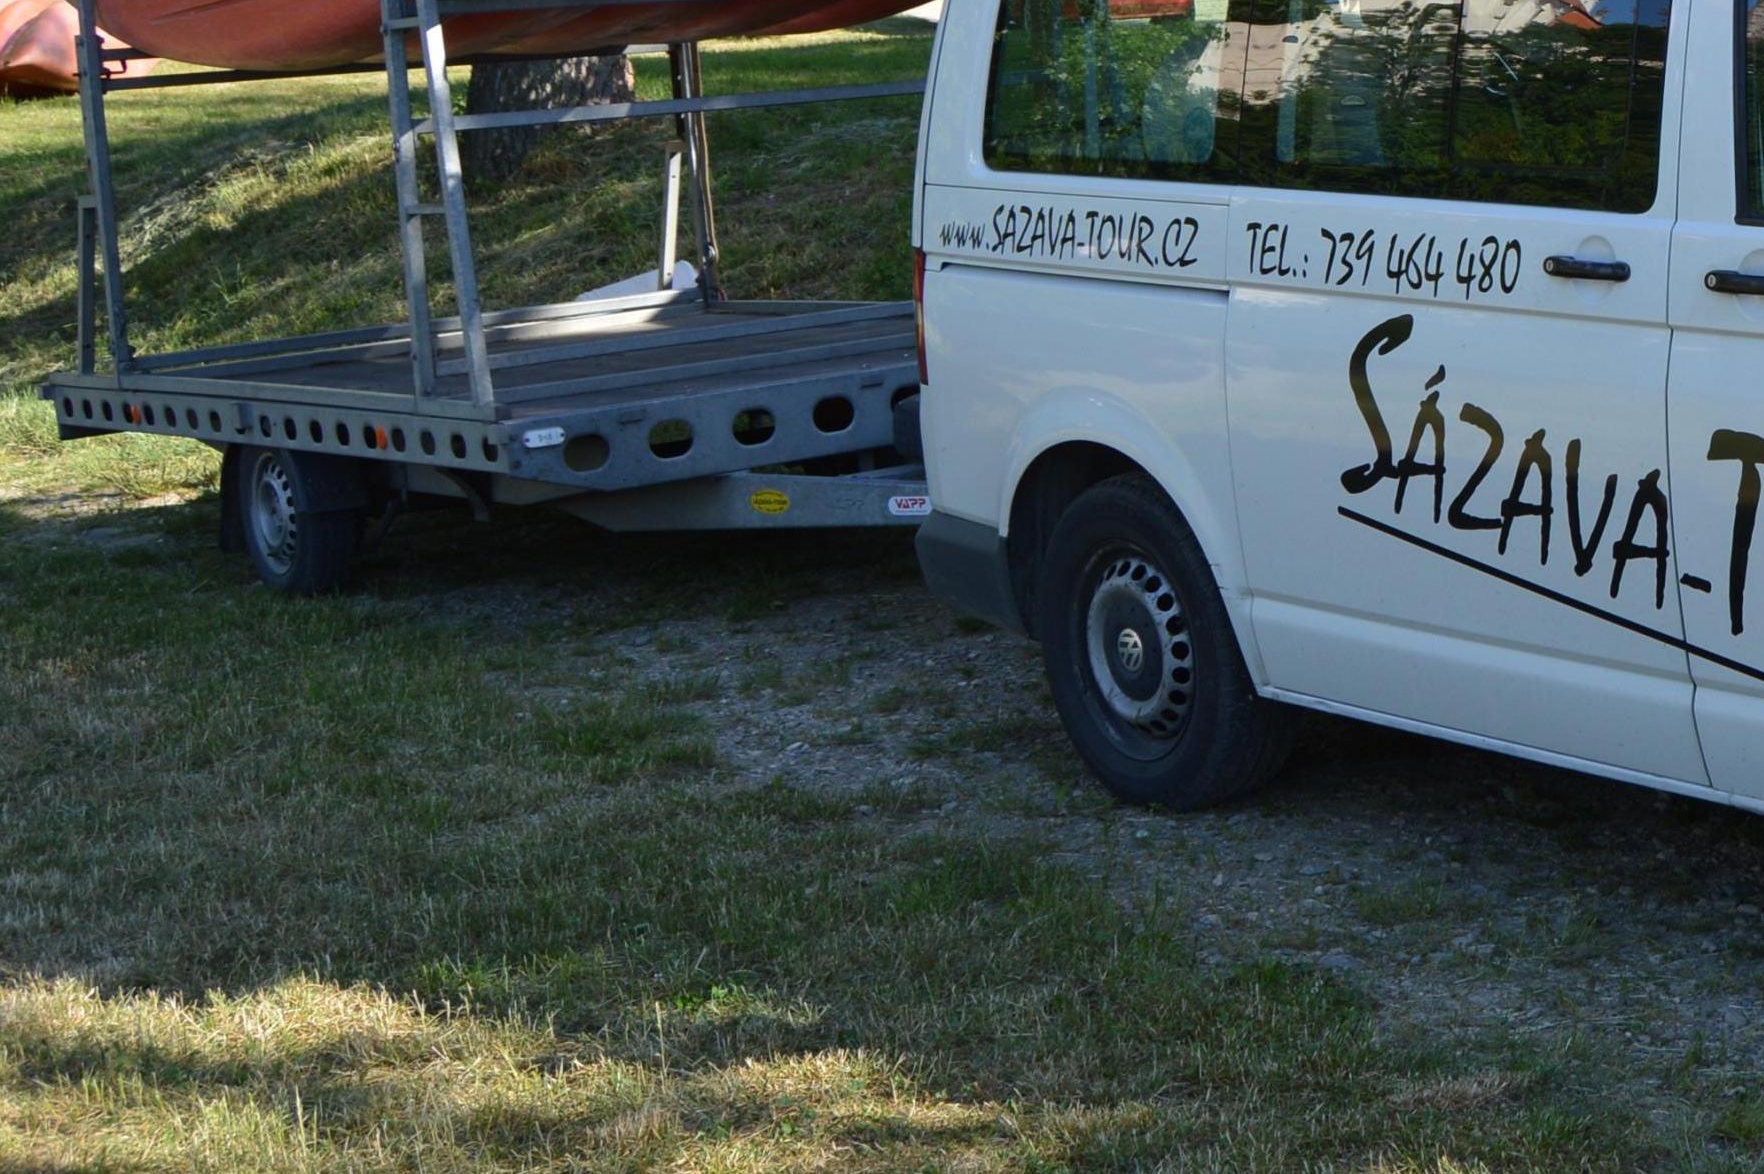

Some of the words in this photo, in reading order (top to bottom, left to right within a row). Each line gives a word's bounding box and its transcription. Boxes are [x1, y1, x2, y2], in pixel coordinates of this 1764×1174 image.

[1246, 222, 1308, 278] TEL.:
[1321, 227, 1375, 286] 739
[1386, 233, 1444, 297] 464
[1456, 236, 1522, 300] 480
[895, 498, 926, 509] VAPP
